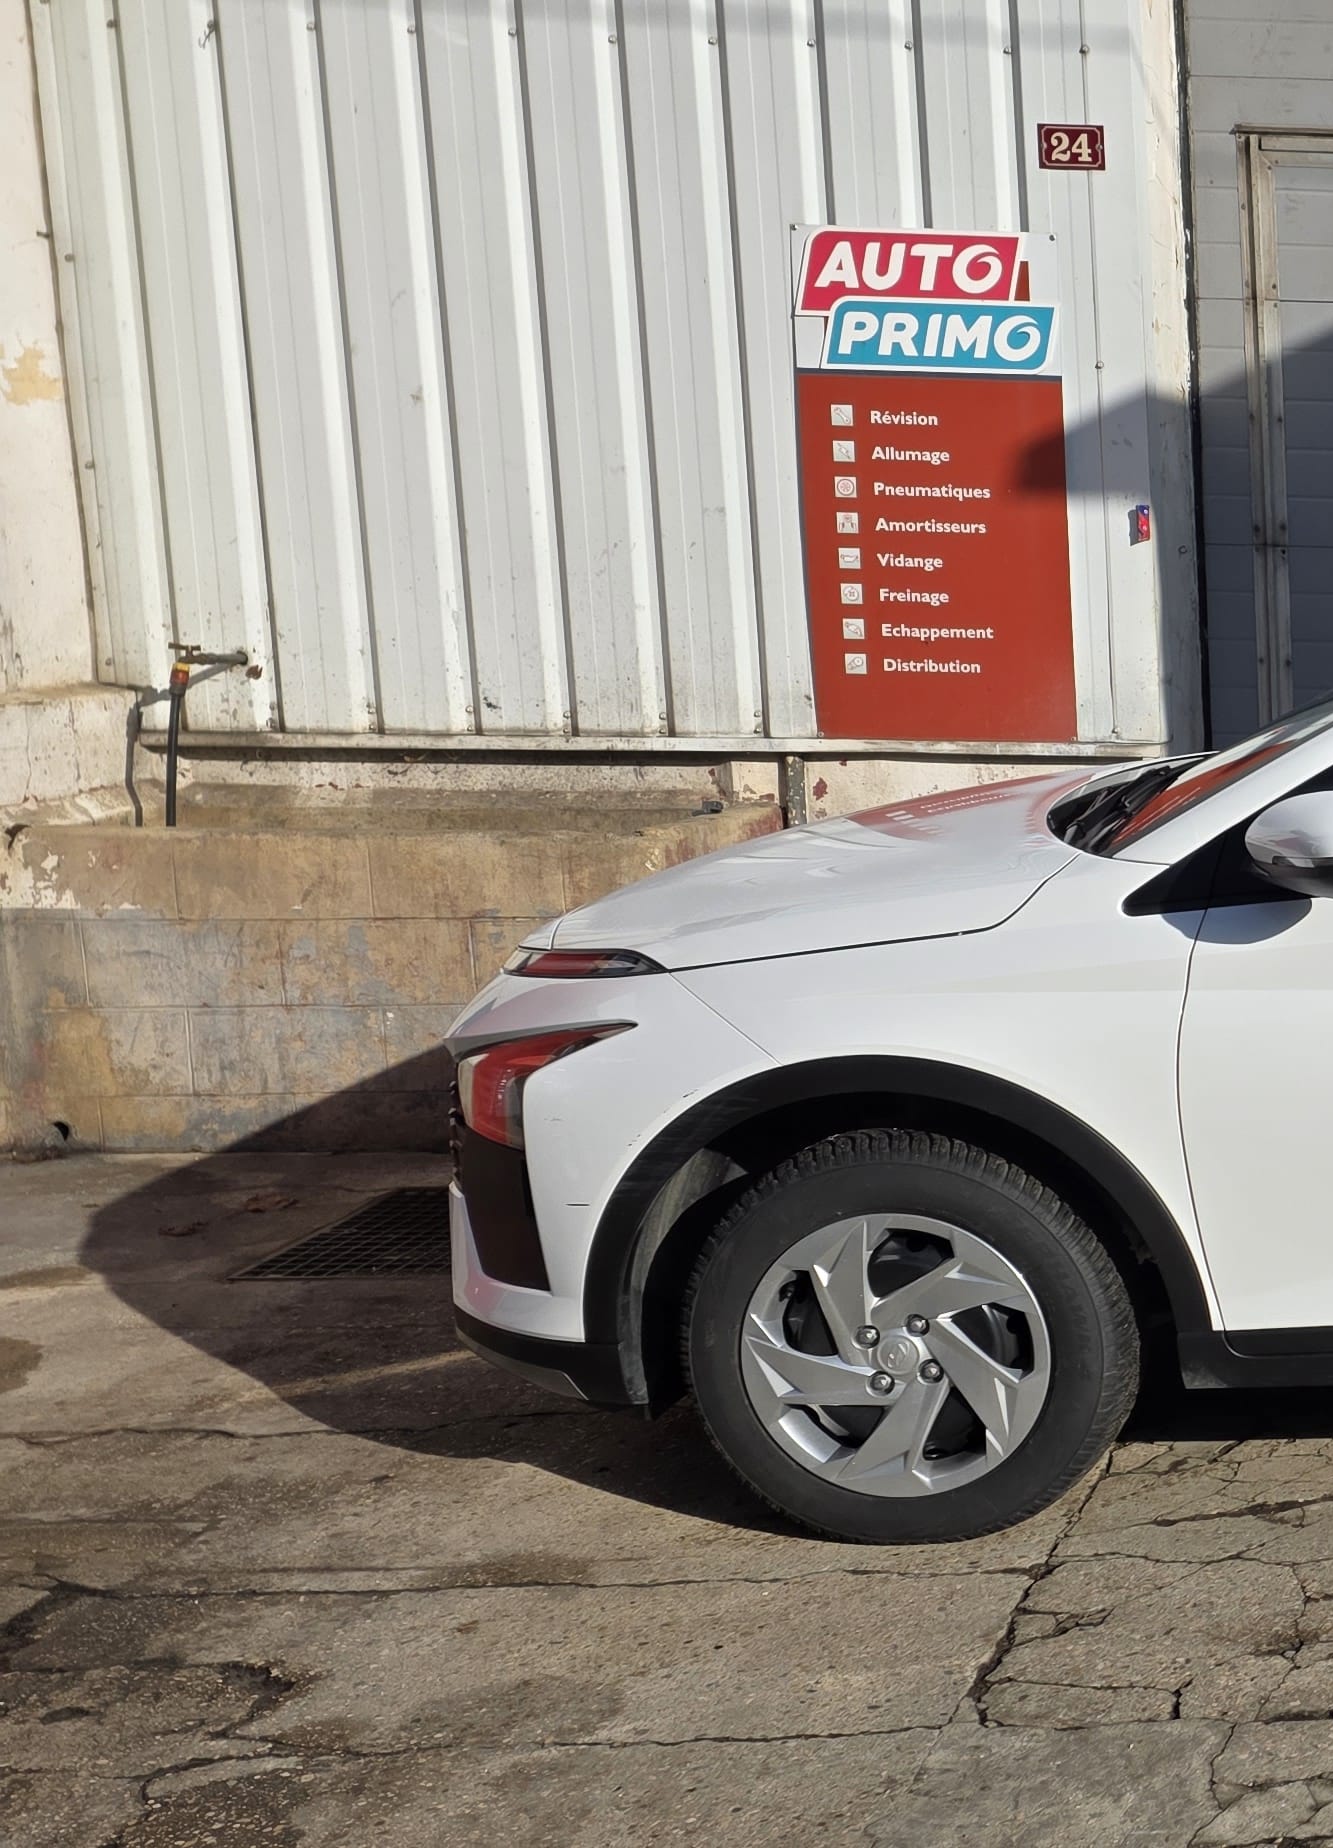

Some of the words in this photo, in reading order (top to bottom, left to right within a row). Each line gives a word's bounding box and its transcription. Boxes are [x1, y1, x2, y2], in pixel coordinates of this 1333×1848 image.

[1049, 132, 1093, 163] 24
[813, 241, 1003, 294] AUTO
[837, 310, 1041, 363] PRIMO
[870, 409, 939, 428] Révision
[871, 445, 950, 466] Allumage
[872, 481, 991, 502] Pneumatiques
[875, 516, 987, 536] Amortisseurs
[876, 551, 943, 573] Vidange
[879, 586, 950, 607] Freinage
[880, 622, 995, 644] Echappement
[882, 657, 982, 676] Distribution
